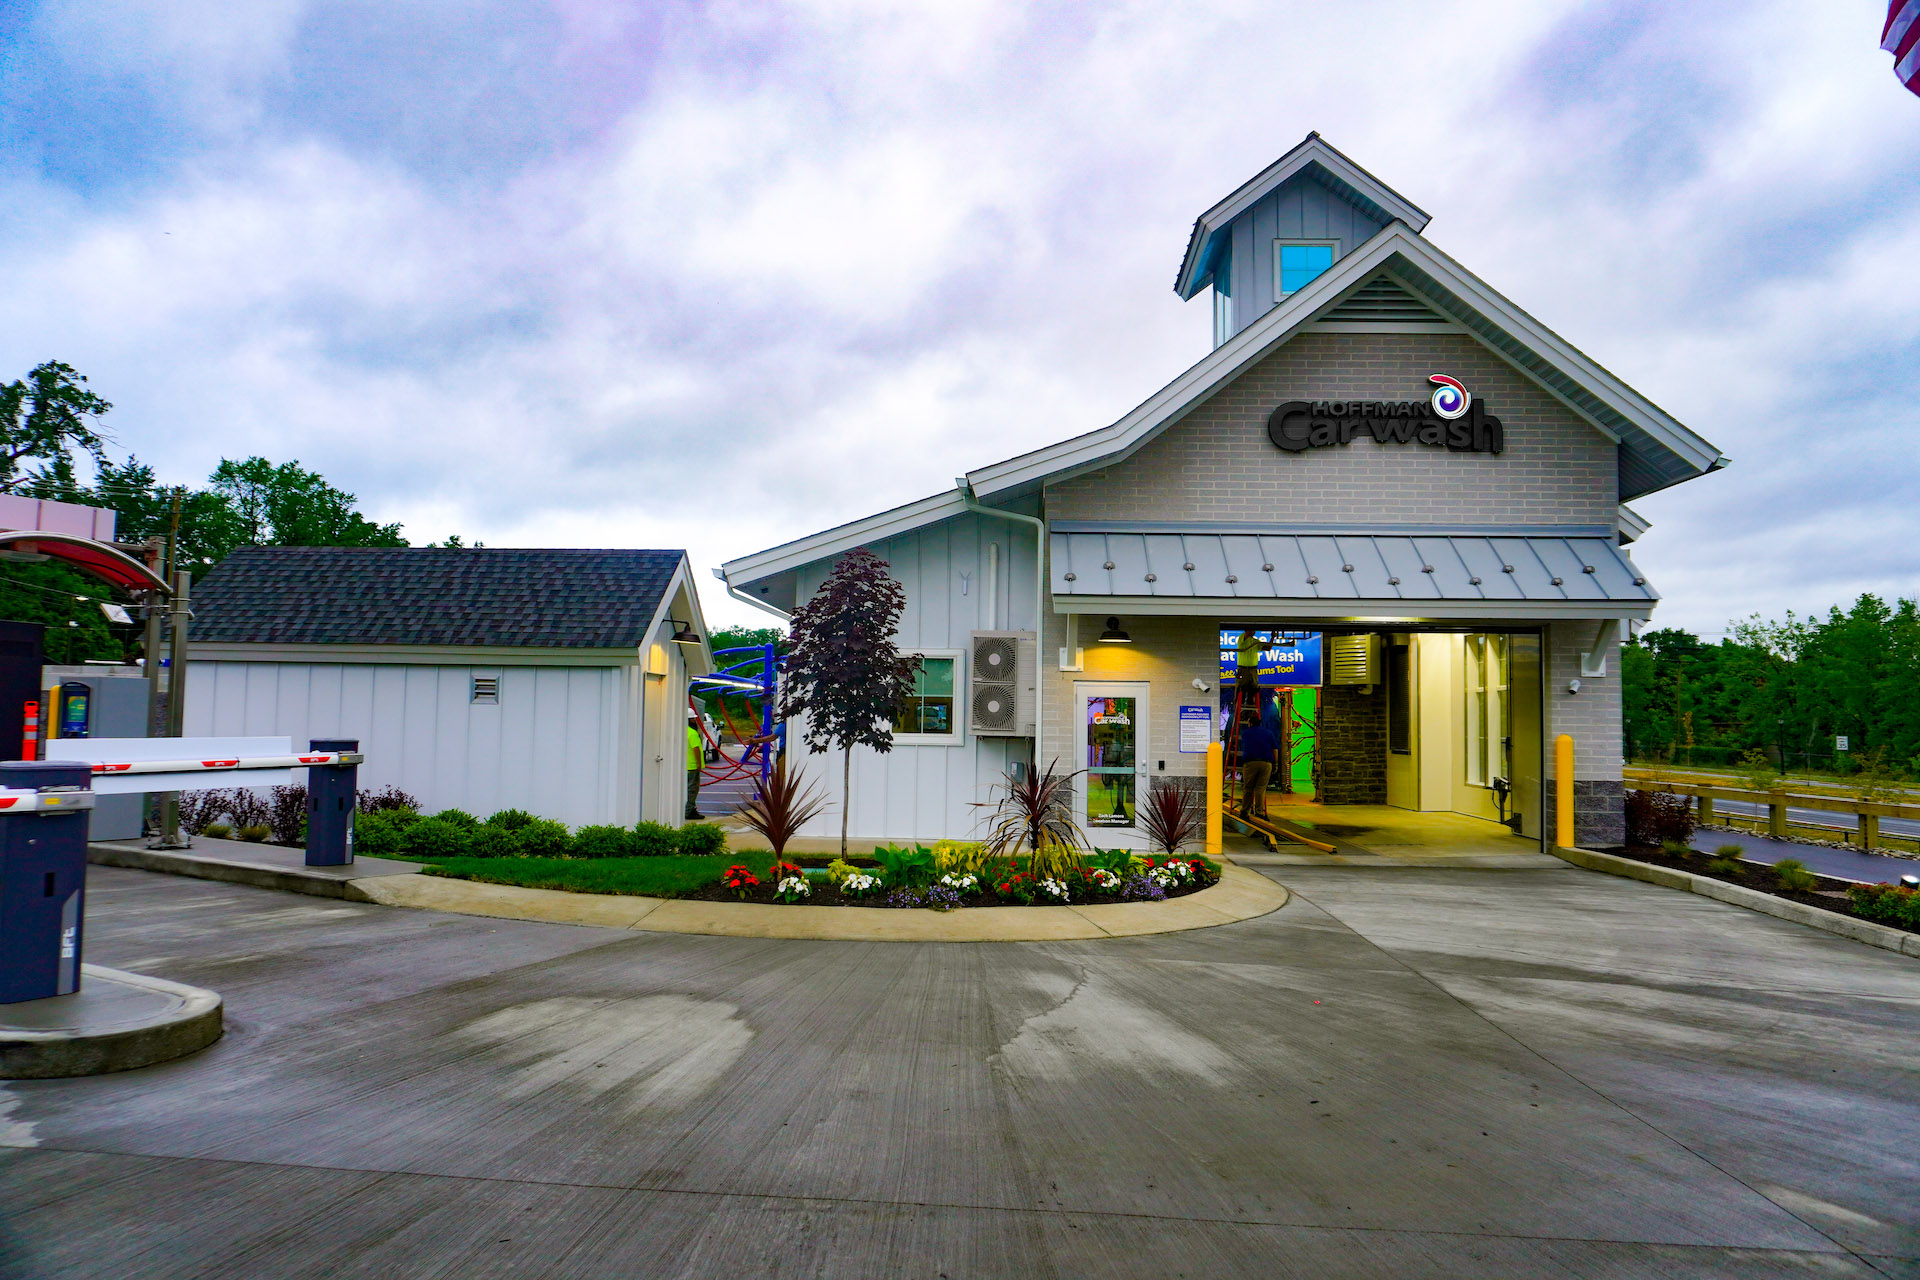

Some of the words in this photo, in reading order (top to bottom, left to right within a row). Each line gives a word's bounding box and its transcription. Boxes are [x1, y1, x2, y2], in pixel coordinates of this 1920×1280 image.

[1312, 401, 1432, 417] HOFFMAN
[1265, 649, 1304, 662] Wash
[1275, 664, 1295, 674] Too!
